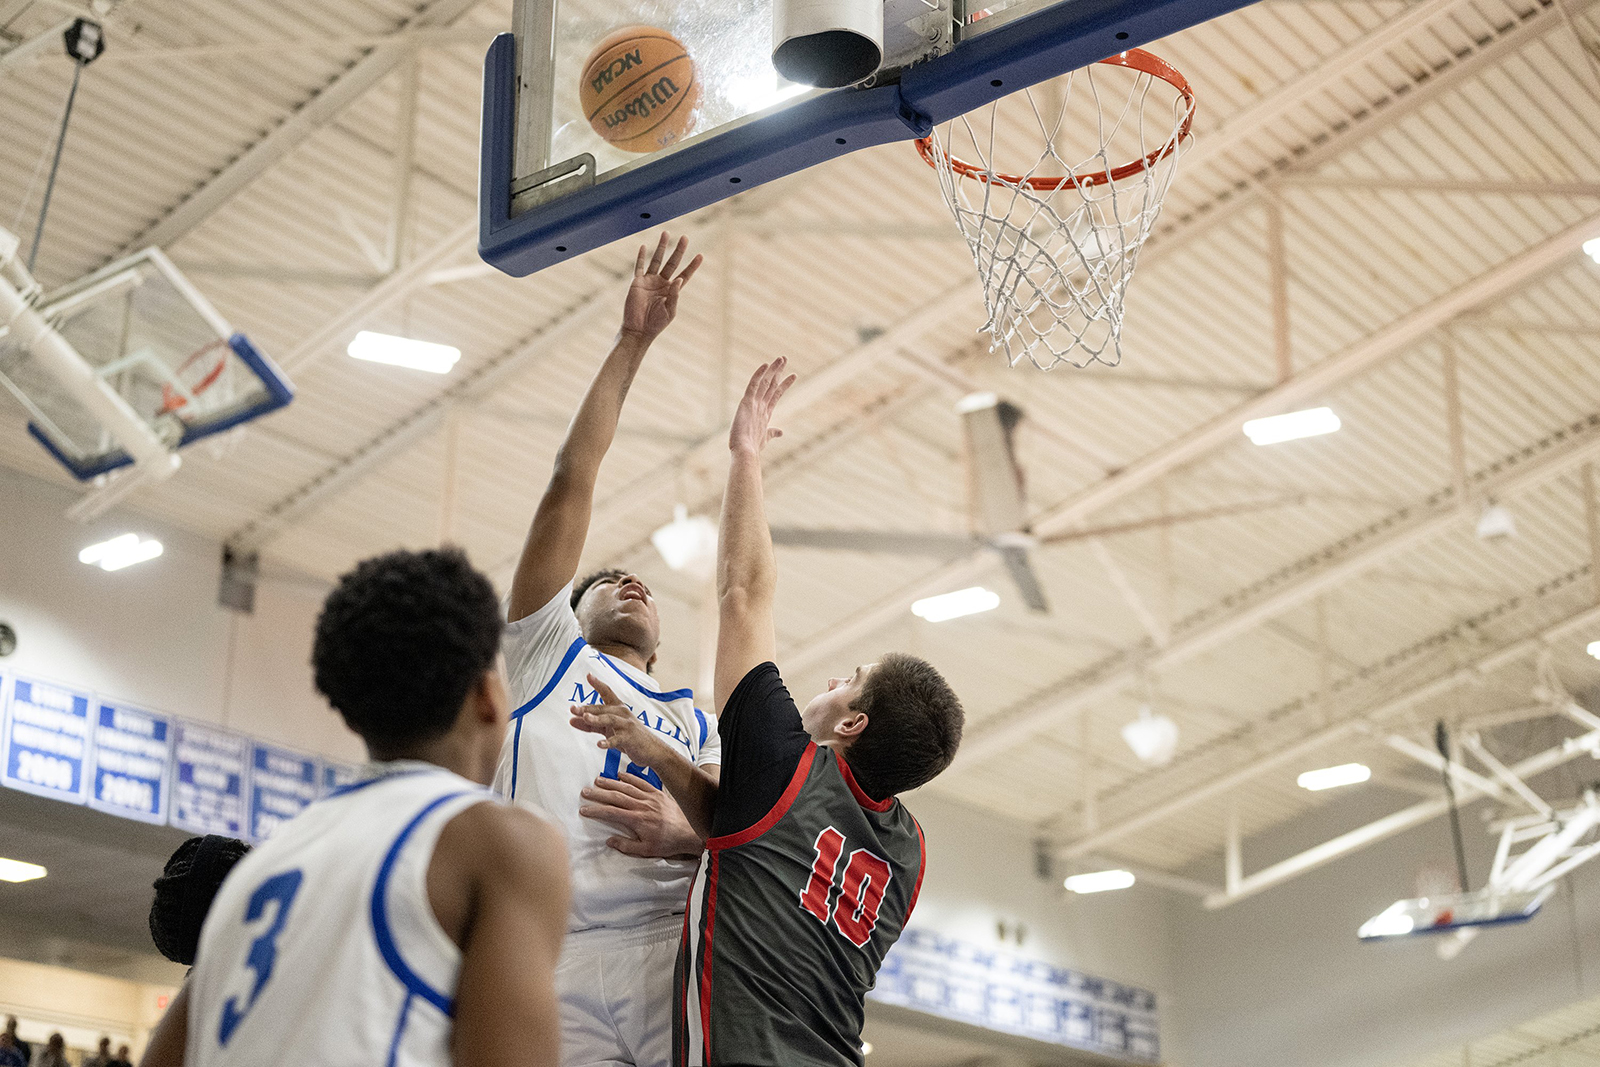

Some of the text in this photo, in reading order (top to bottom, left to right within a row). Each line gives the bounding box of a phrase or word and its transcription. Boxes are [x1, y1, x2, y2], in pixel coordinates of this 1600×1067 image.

[591, 48, 643, 94] NCAA
[602, 76, 679, 129] Wilson
[799, 825, 893, 949] 10
[218, 868, 304, 1048] 3
